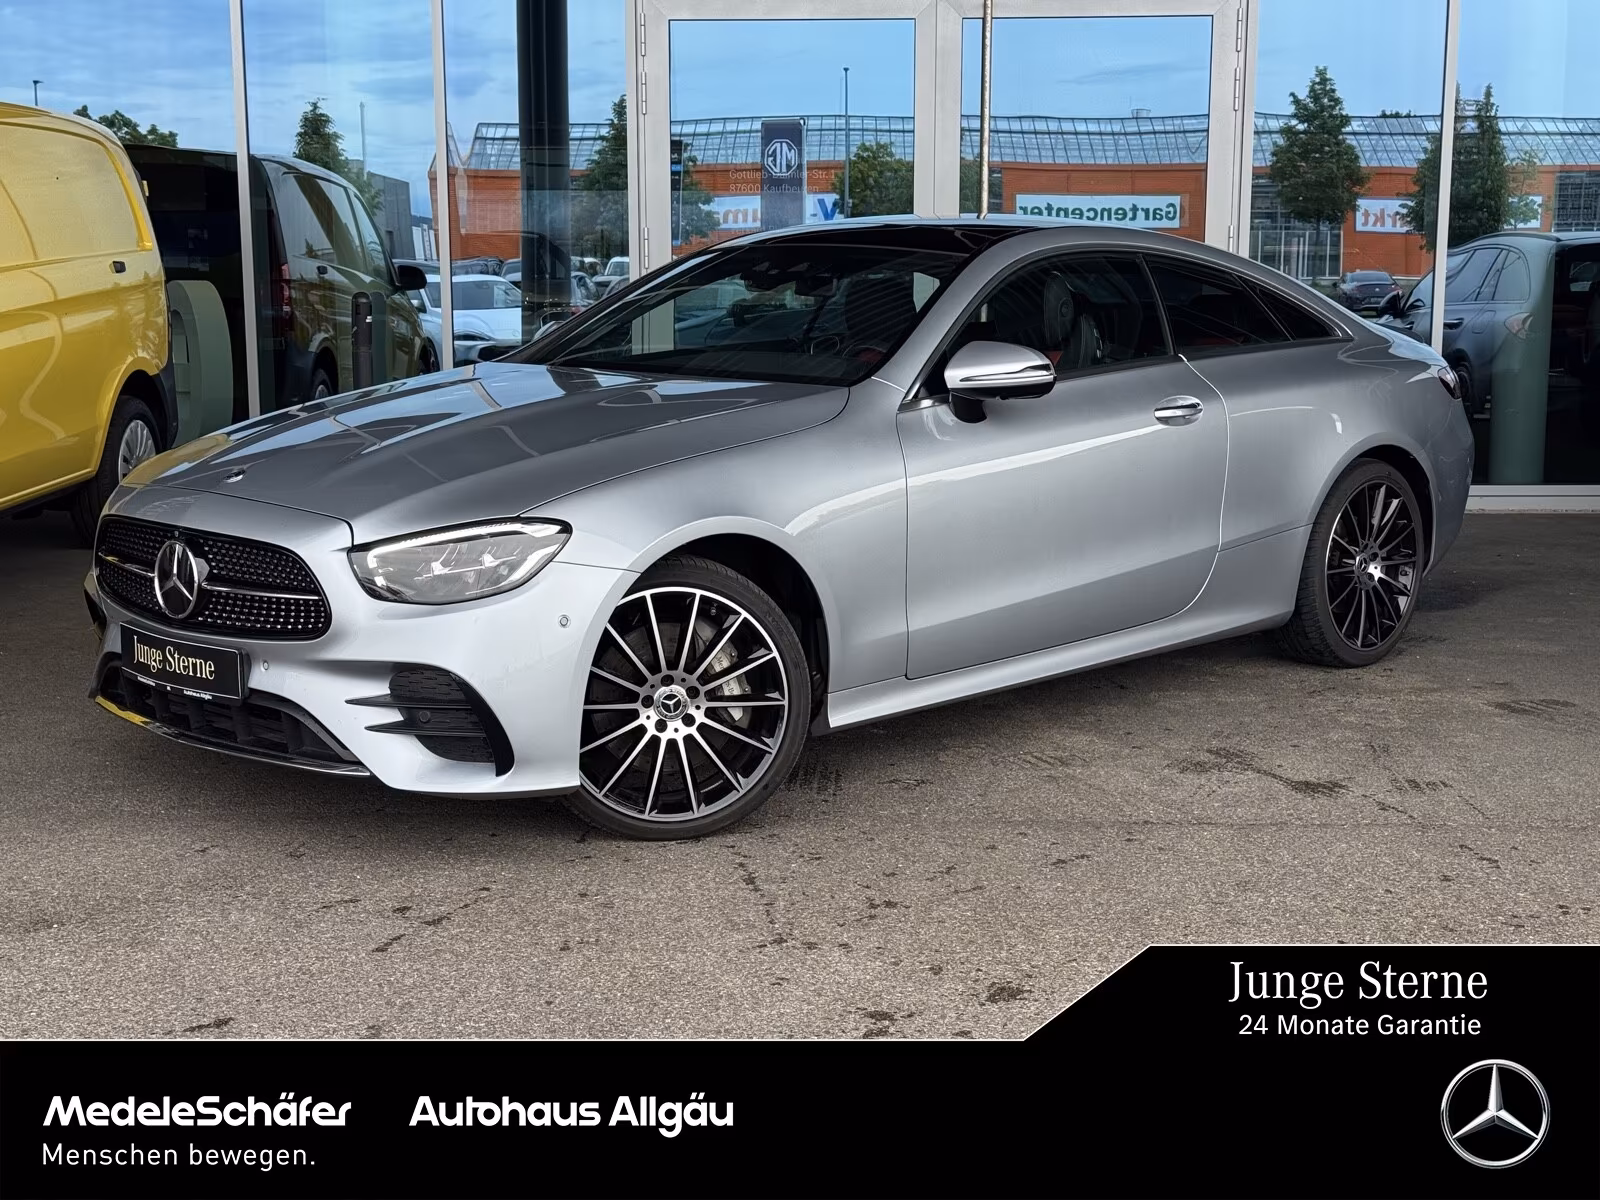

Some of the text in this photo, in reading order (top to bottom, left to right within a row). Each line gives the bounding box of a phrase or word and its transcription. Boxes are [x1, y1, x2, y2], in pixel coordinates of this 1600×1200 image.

[729, 183, 819, 193] 87600 Kaufbeuen
[133, 635, 215, 680] Junge Sterne
